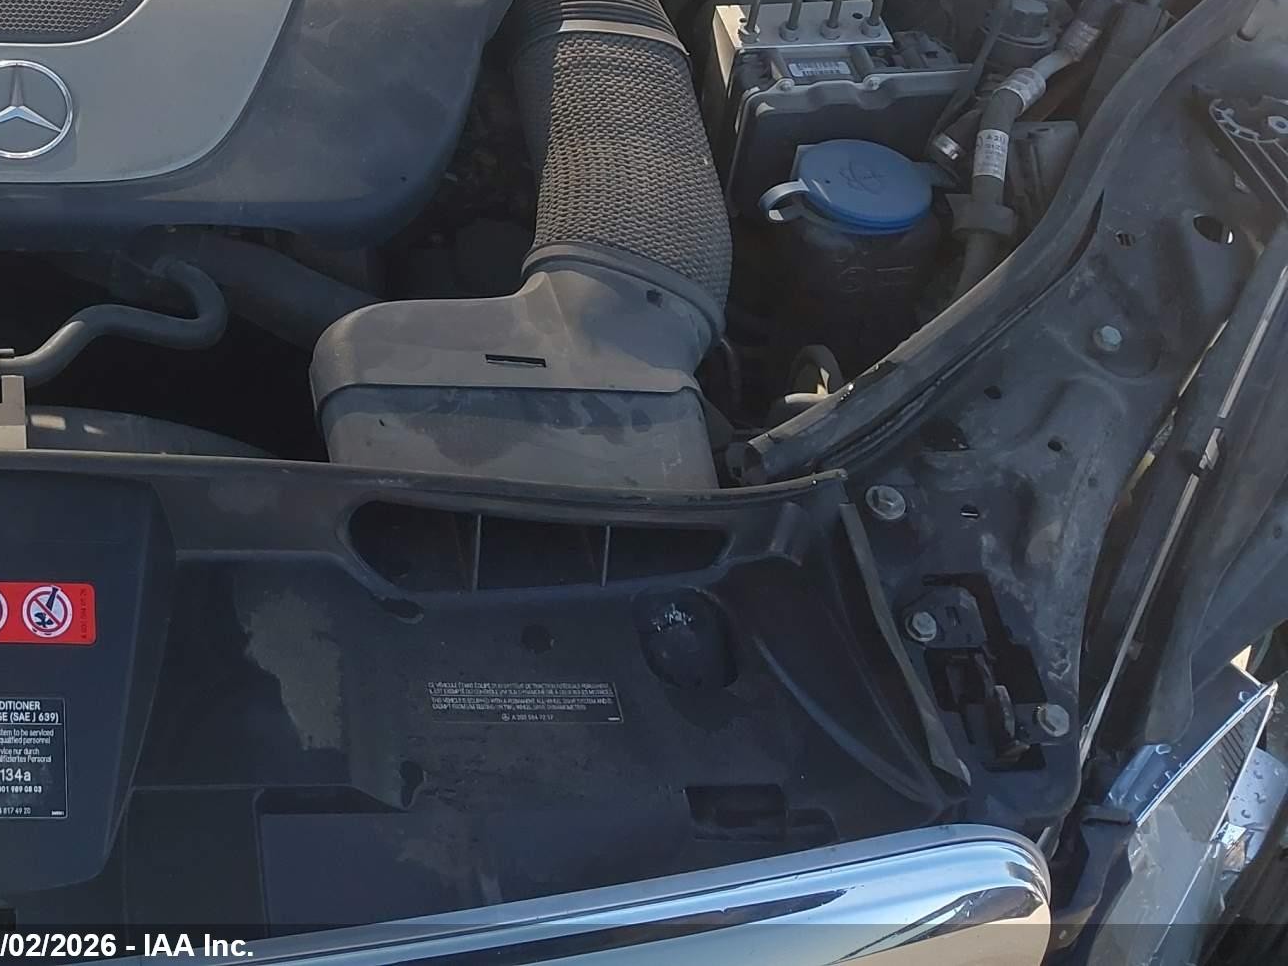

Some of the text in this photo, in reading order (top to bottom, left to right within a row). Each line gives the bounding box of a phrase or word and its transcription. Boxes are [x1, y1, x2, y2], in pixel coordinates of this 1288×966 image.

[10, 712, 31, 724] (SAE
[32, 712, 36, 722] J
[38, 712, 59, 724] 639)
[13, 728, 20, 736] to
[20, 728, 29, 736] be
[29, 728, 54, 737] serviced
[23, 737, 51, 745] personnel
[23, 747, 40, 755] durch
[27, 754, 52, 763] Personal
